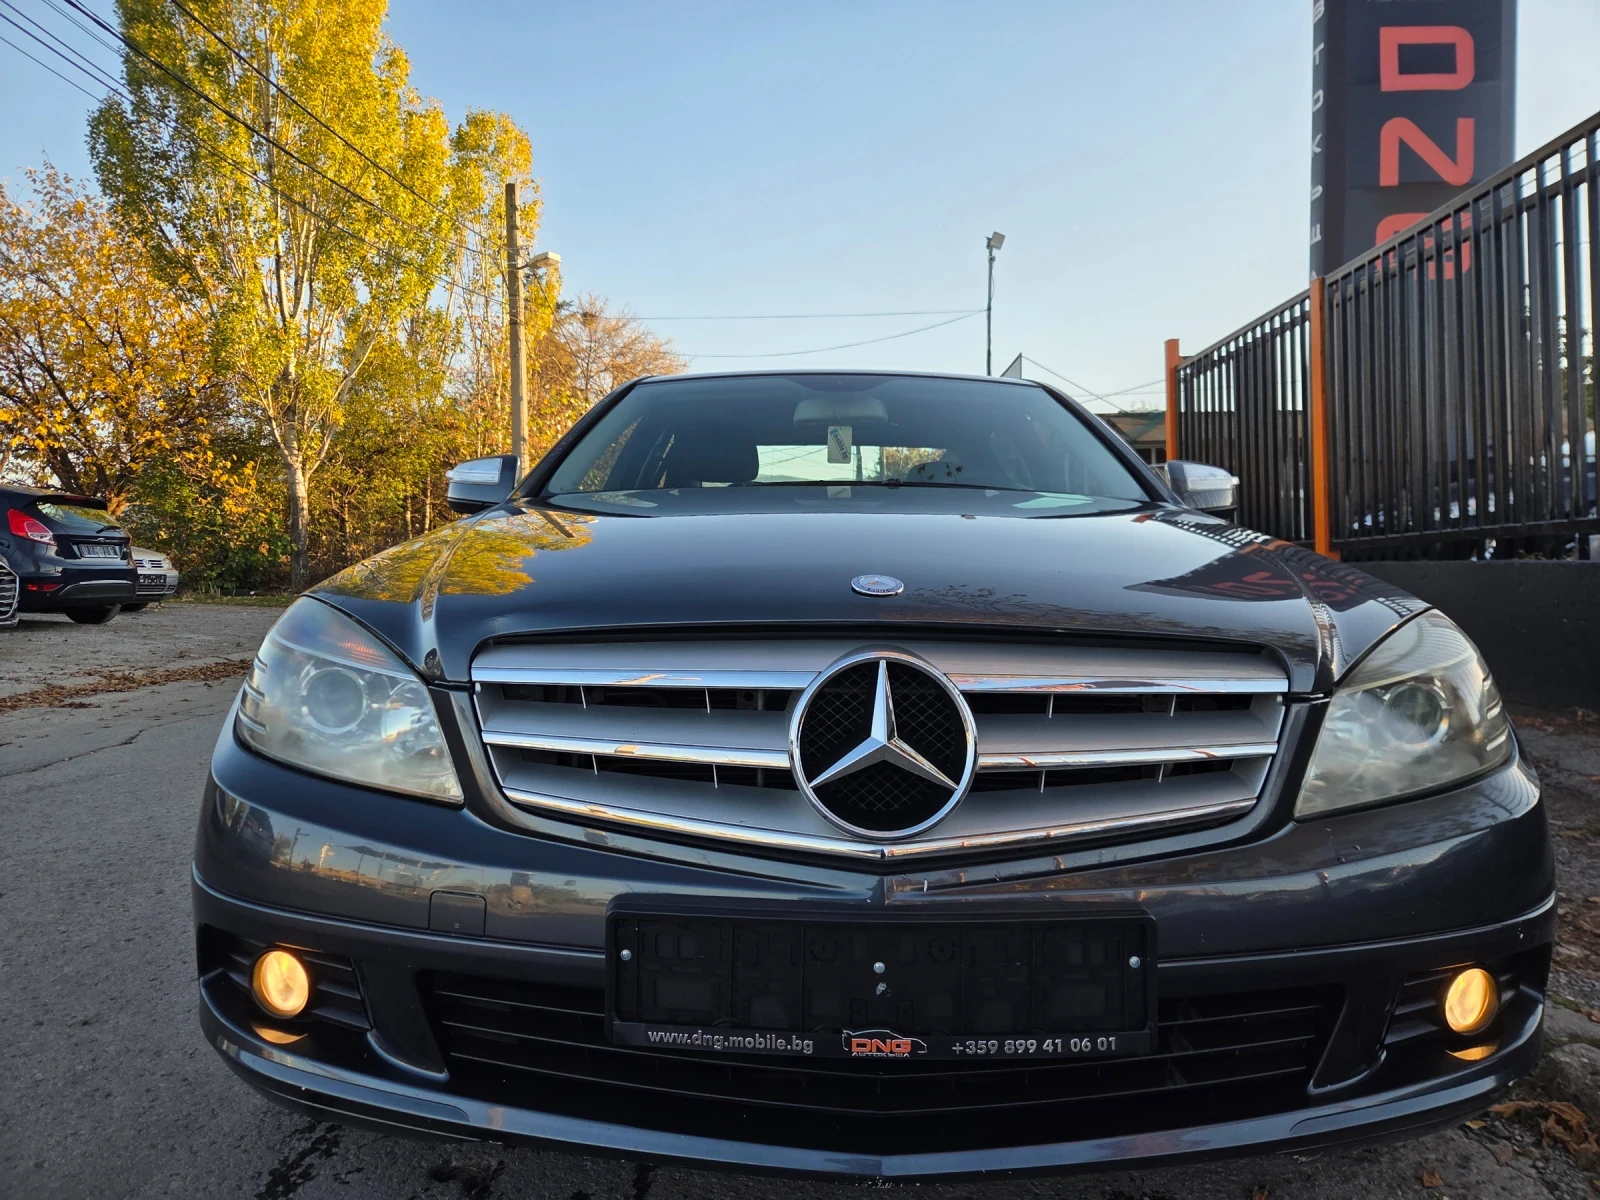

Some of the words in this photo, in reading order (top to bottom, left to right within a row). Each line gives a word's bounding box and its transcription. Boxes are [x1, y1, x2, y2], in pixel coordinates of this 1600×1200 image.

[647, 1030, 814, 1054] www.dng.mobile.bg
[851, 1038, 912, 1053] DNG
[951, 1040, 999, 1055] +359
[1004, 1039, 1038, 1054] 899
[1042, 1039, 1063, 1053] 41
[1070, 1038, 1092, 1052] 06
[1097, 1037, 1117, 1051] 01
